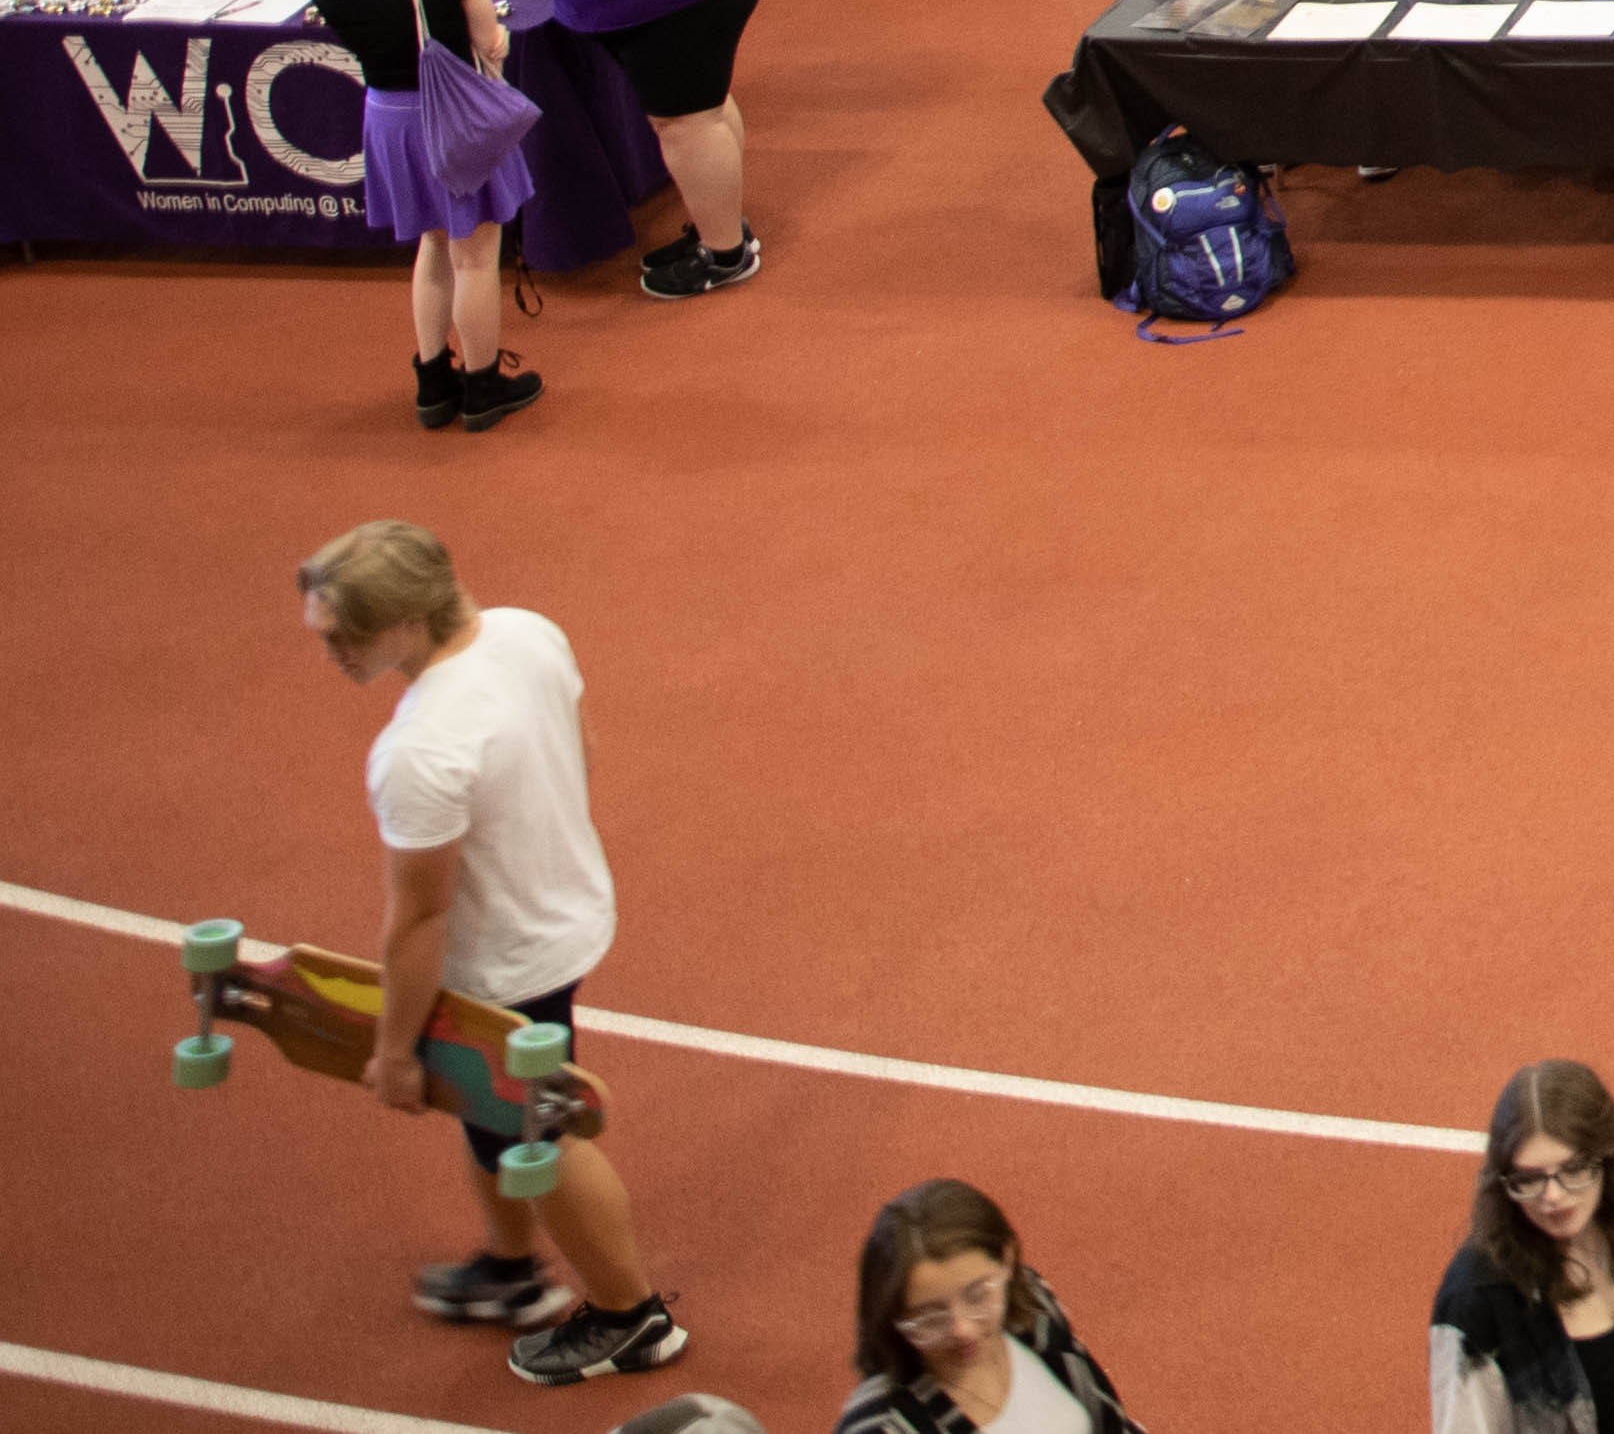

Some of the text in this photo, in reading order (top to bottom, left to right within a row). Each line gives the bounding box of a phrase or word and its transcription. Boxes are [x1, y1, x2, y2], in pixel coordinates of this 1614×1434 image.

[138, 190, 204, 212] Women
[207, 191, 224, 211] in
[225, 192, 316, 219] Computing
[318, 195, 338, 215] @
